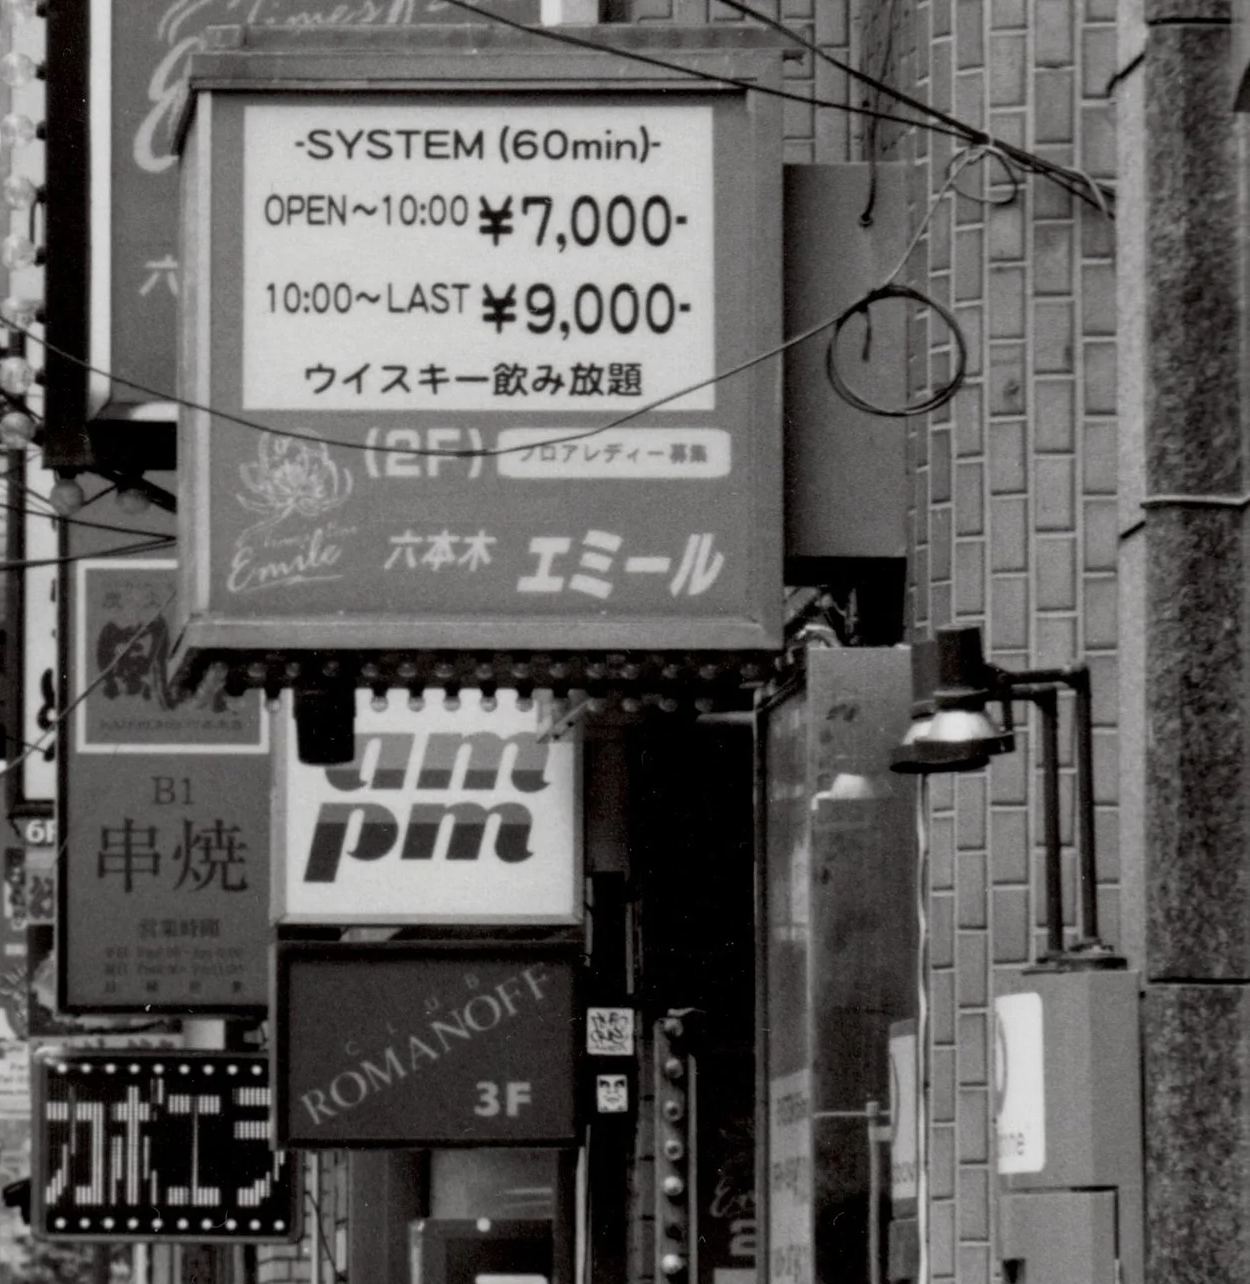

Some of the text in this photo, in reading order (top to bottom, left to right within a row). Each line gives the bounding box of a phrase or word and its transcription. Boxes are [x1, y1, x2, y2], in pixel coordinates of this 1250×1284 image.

[303, 361, 644, 398] ウイスキー飲み放題
[362, 425, 484, 480] (2F)
[383, 529, 497, 571] 六本木
[516, 529, 726, 600] エミール
[151, 776, 194, 806] B1
[96, 818, 250, 895] 串焼
[302, 801, 535, 884] pm
[300, 963, 551, 1125] ROMANOFF
[473, 1080, 532, 1118] 3F
